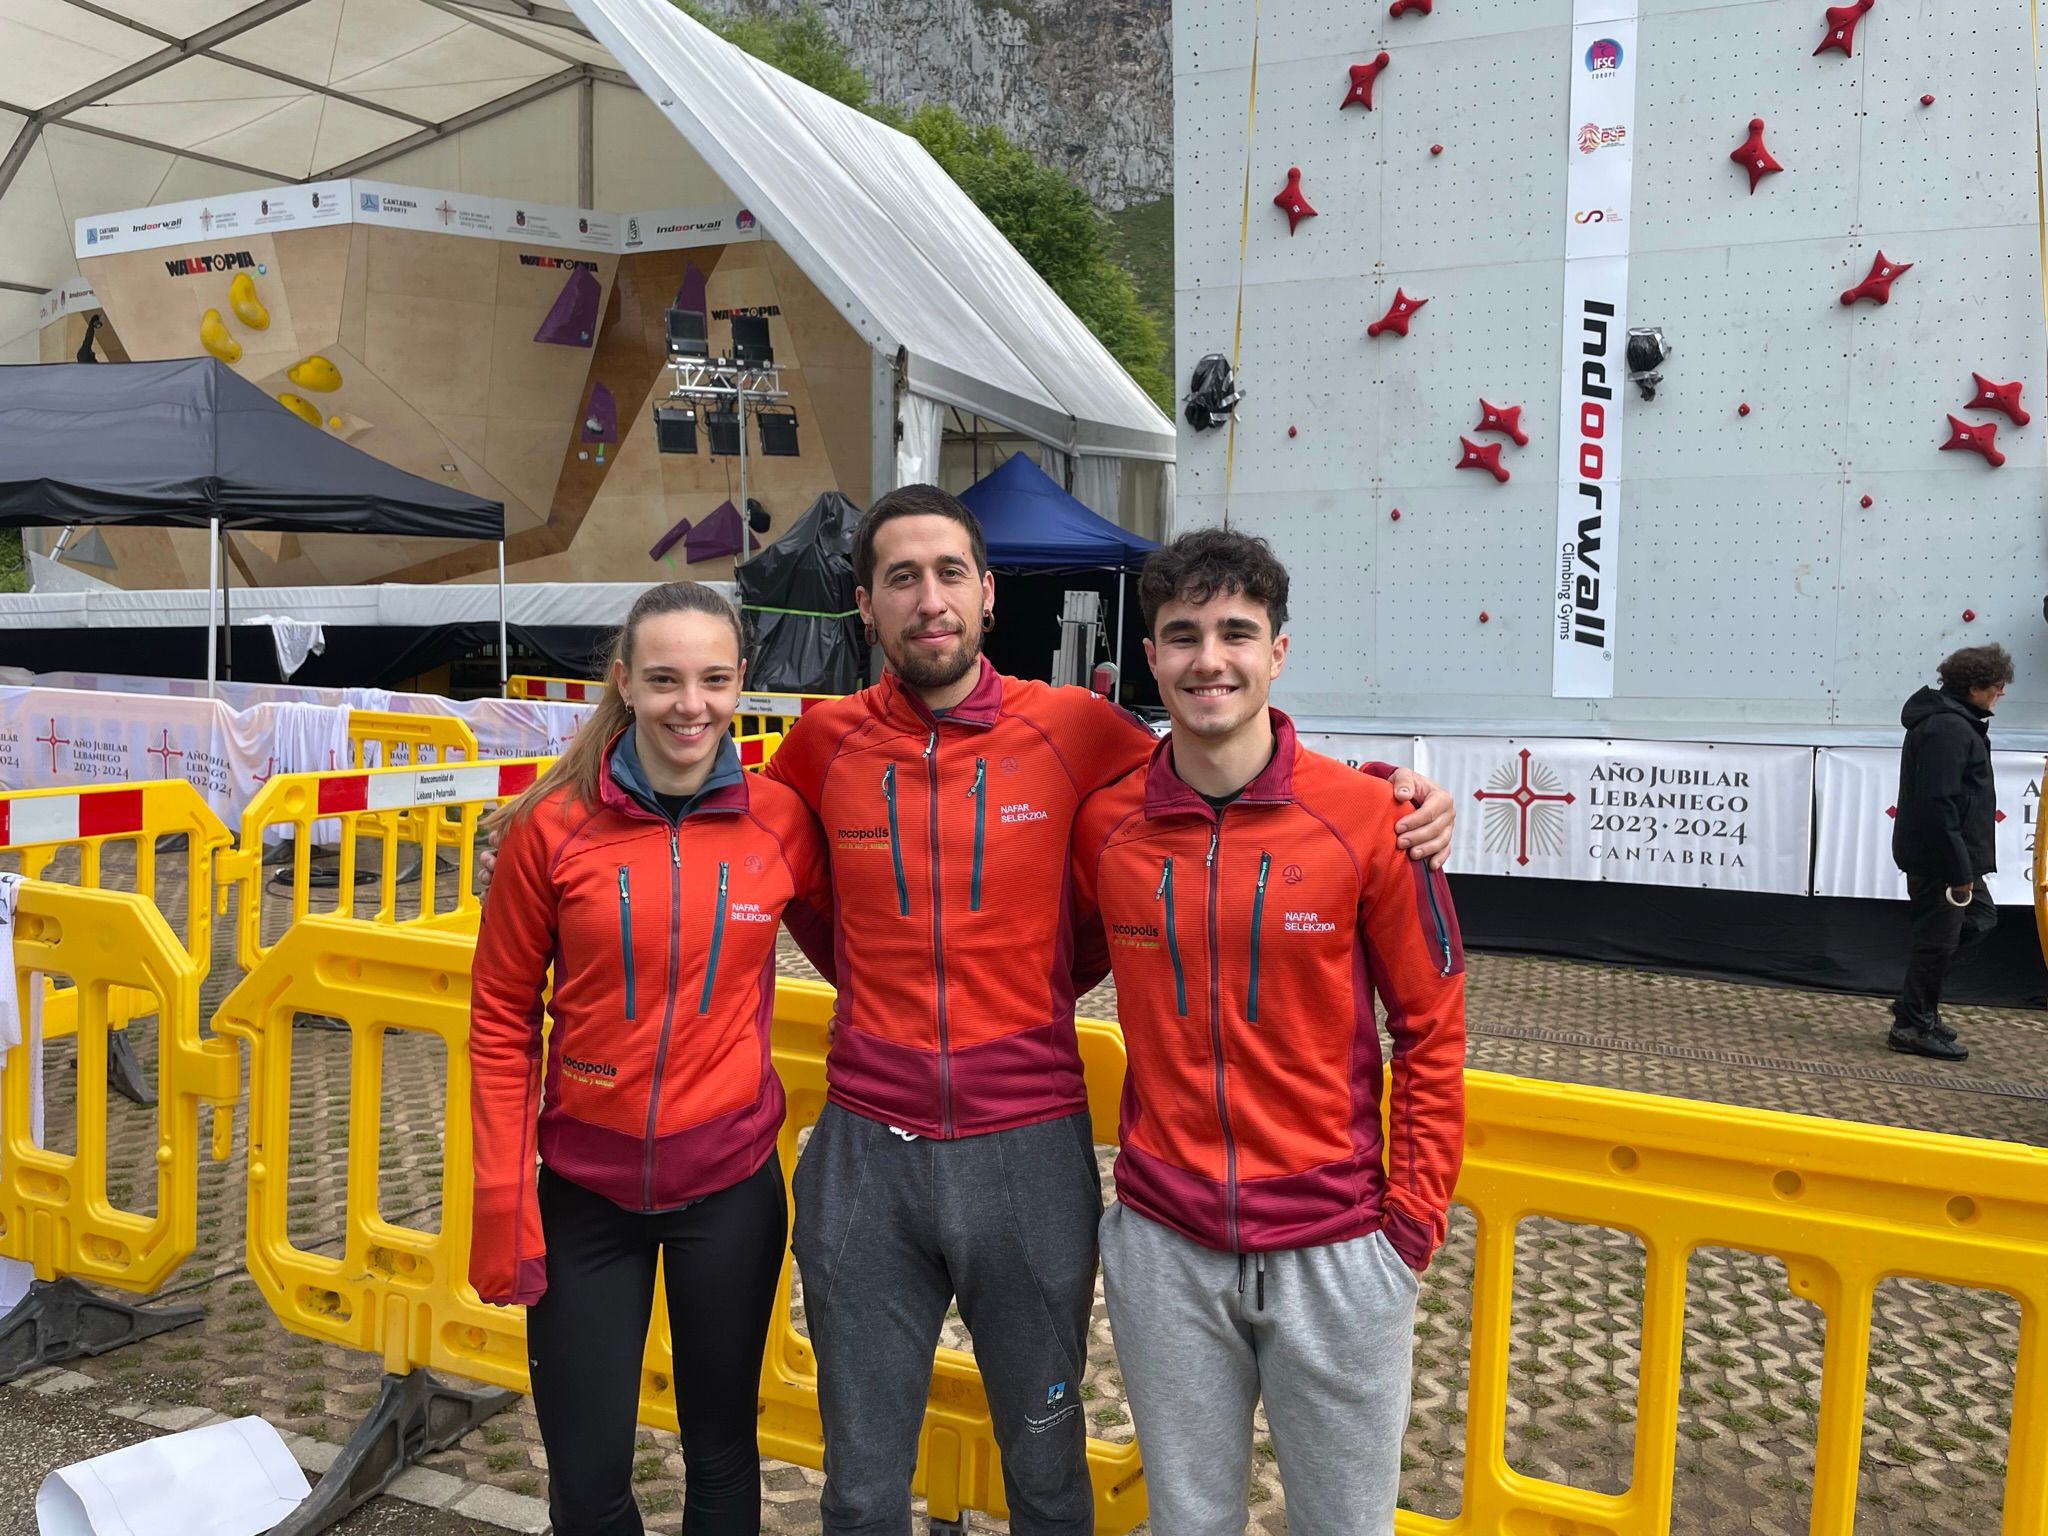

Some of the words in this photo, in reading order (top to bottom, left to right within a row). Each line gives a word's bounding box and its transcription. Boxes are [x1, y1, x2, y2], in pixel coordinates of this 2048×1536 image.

[1593, 56, 1615, 69] IFSC
[1591, 71, 1616, 80] EUROPE
[382, 198, 417, 209] CANTABRIA
[133, 218, 182, 232] Indoorwall
[656, 220, 722, 234] Indoorwall
[165, 251, 255, 277] WALLTOPIA
[1573, 299, 1615, 649] Indoorwall
[1558, 542, 1574, 600] Climbing
[1559, 602, 1573, 641] Gyms
[73, 738, 92, 749] AÑO
[187, 750, 208, 760] AÑO
[1590, 762, 1645, 783] AÑO
[1000, 803, 1029, 813] NAFAR
[1001, 811, 1048, 823] SELEKZIOA
[838, 827, 889, 841] rocopolis
[1589, 845, 1745, 867] CANTABRIA
[732, 902, 760, 913] NAFAR
[731, 911, 772, 923] SELEKZIOA
[1285, 912, 1318, 922] NAFAR
[1284, 921, 1336, 932] SELEKZIOA
[563, 1055, 618, 1077] rocopolis
